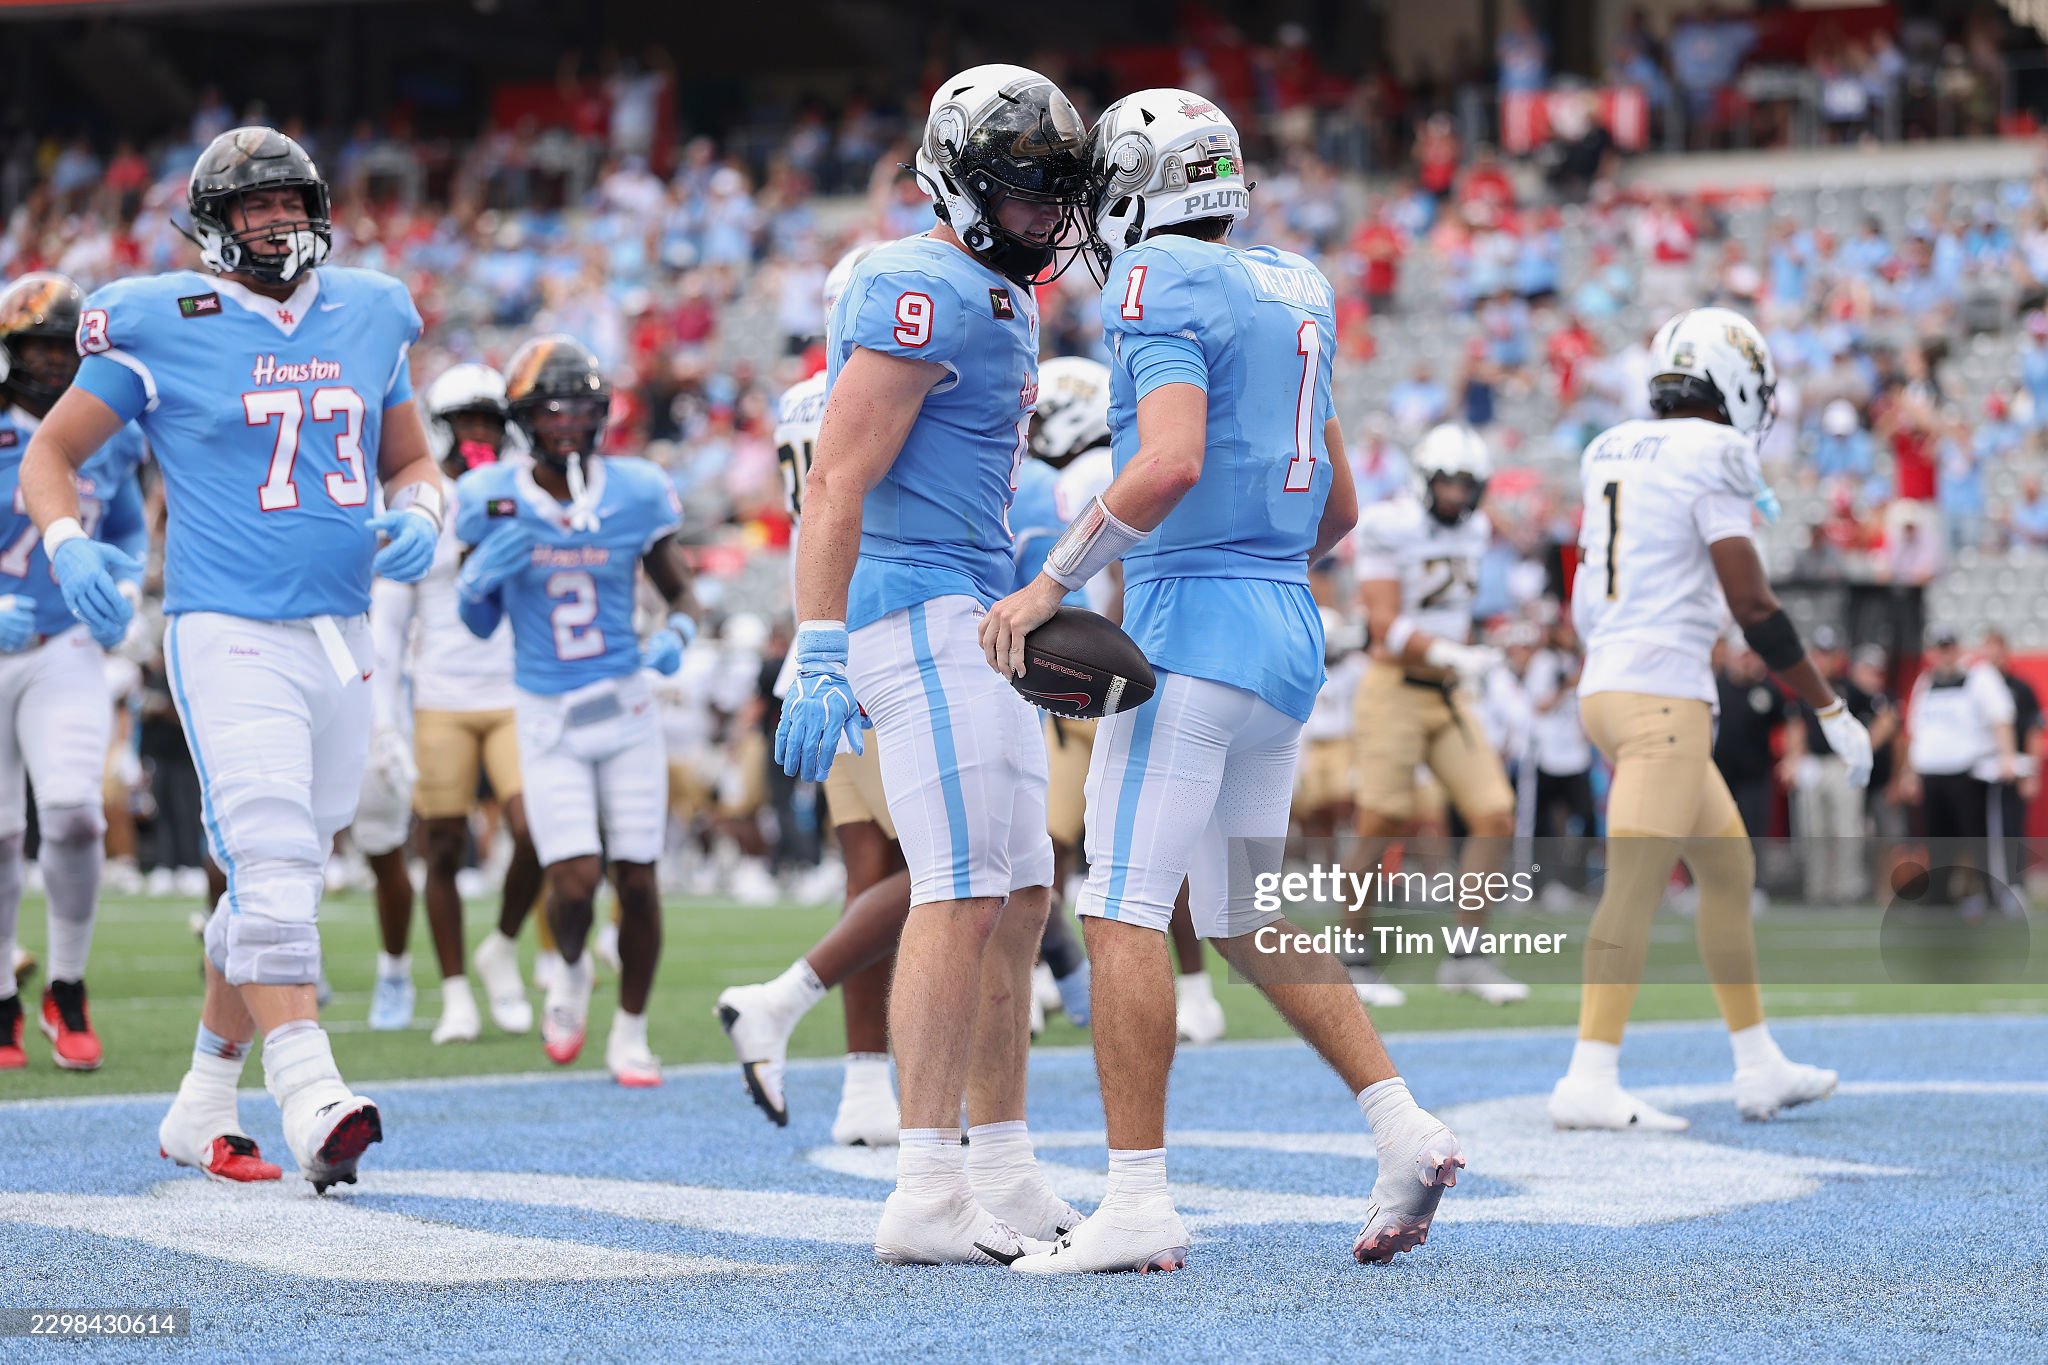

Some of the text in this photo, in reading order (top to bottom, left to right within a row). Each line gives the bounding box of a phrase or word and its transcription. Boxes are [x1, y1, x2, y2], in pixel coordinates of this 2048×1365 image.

[1184, 190, 1249, 215] PLUTO
[1121, 265, 1149, 320] 1
[1244, 259, 1329, 308] WEIGMAN
[893, 291, 935, 348] 9
[251, 353, 341, 386] Houston
[1283, 320, 1321, 492] 1
[242, 386, 368, 512] 73
[1602, 480, 1622, 601] 1
[547, 571, 606, 661] 2
